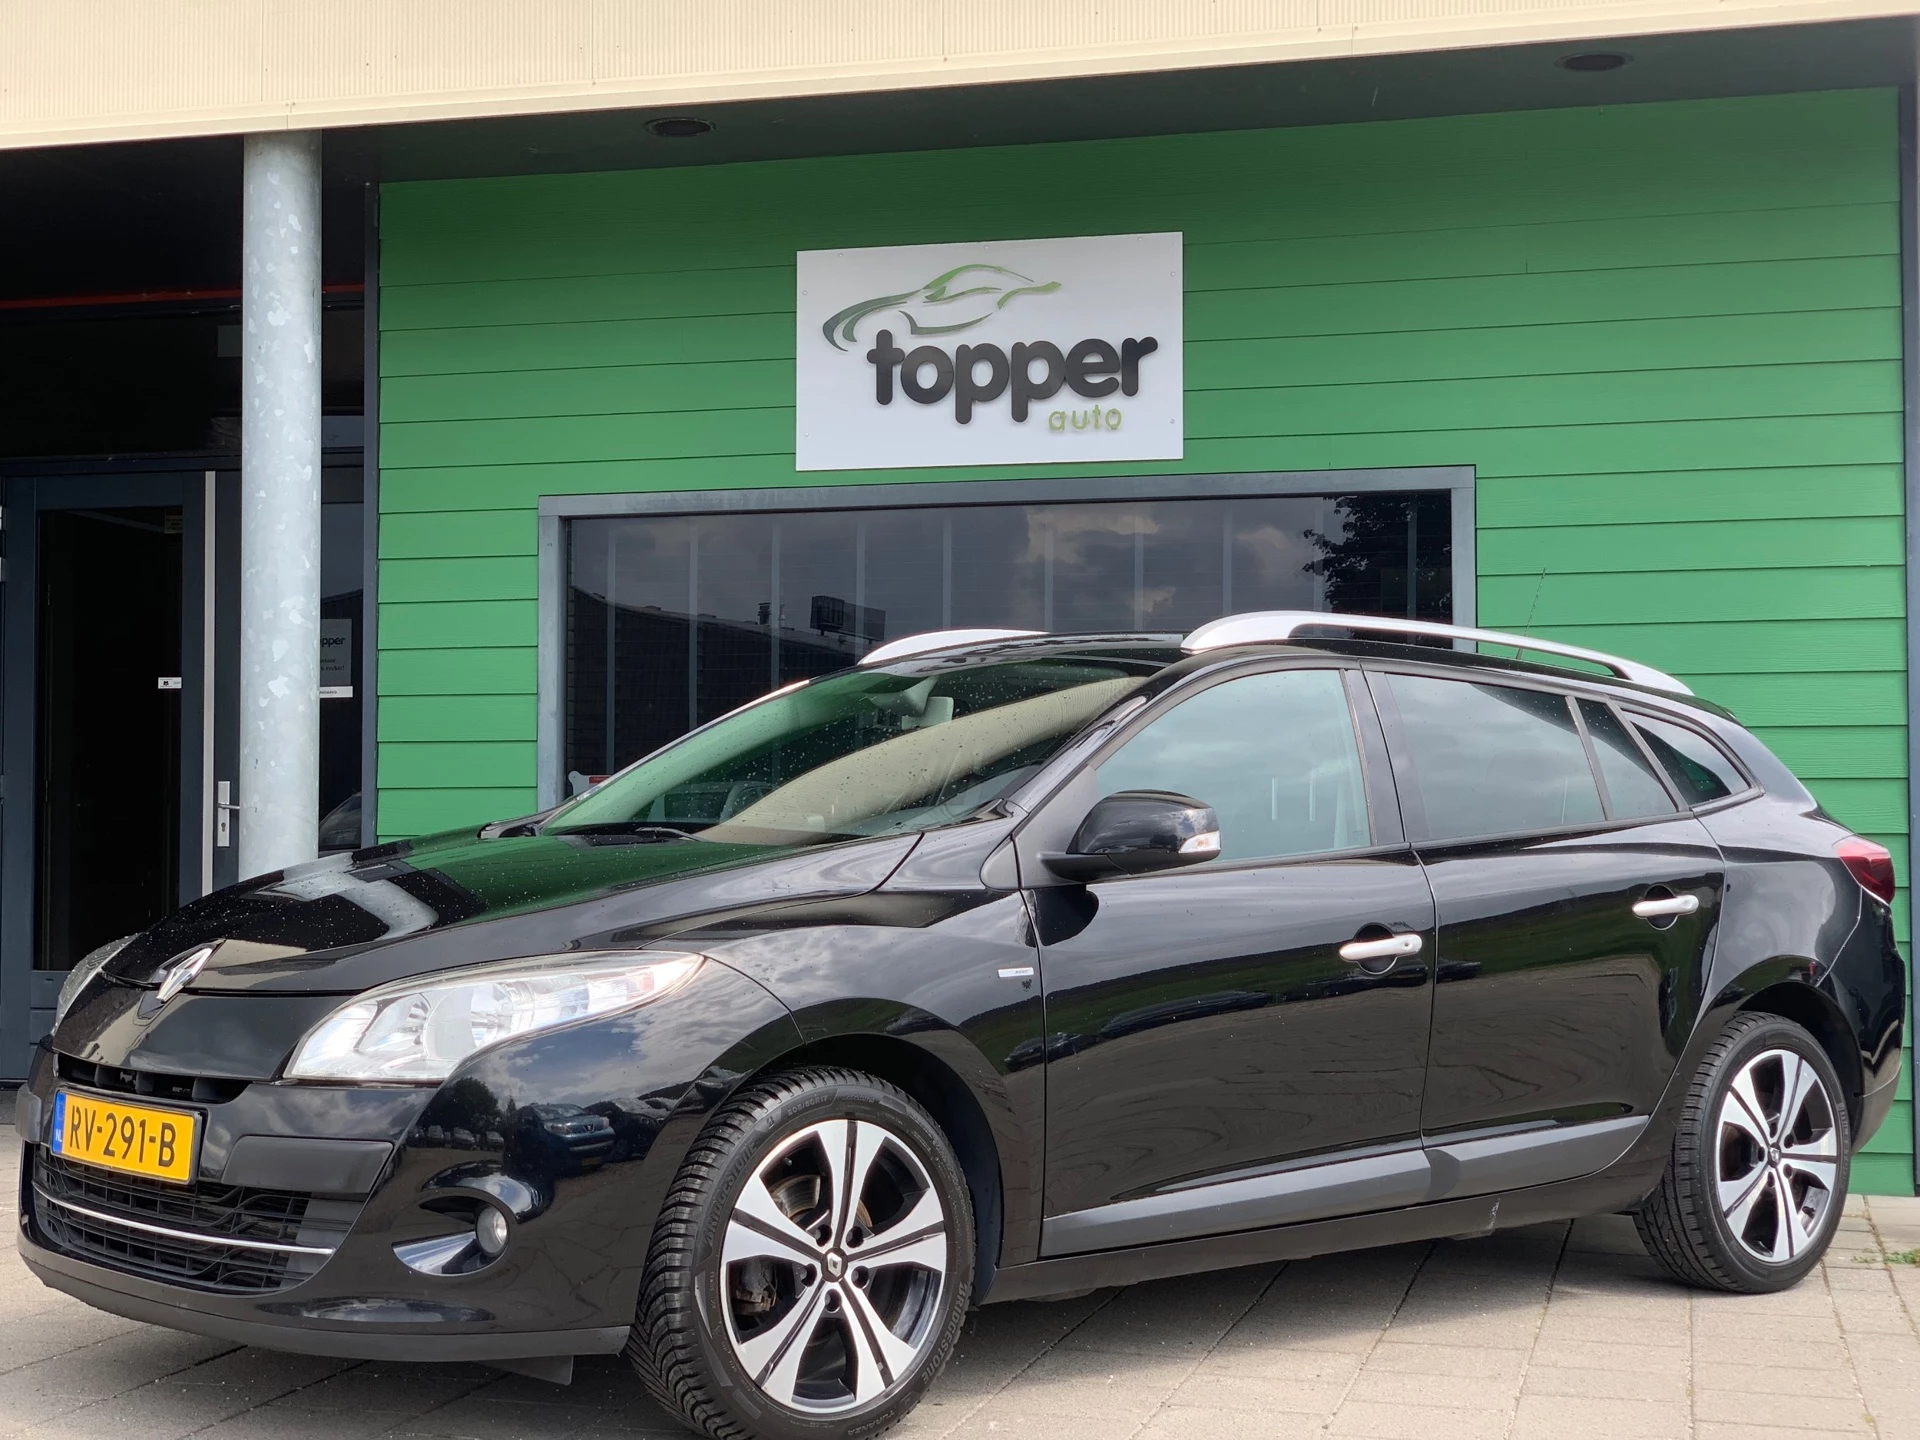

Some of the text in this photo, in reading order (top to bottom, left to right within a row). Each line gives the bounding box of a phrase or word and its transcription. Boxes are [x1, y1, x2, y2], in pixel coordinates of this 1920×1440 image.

[866, 329, 1158, 424] topper
[1048, 404, 1122, 431] auto
[320, 637, 346, 648] pper
[55, 1128, 63, 1143] NL
[69, 1104, 177, 1168] RV-291-B
[921, 1280, 969, 1385] BRIDGESTONE
